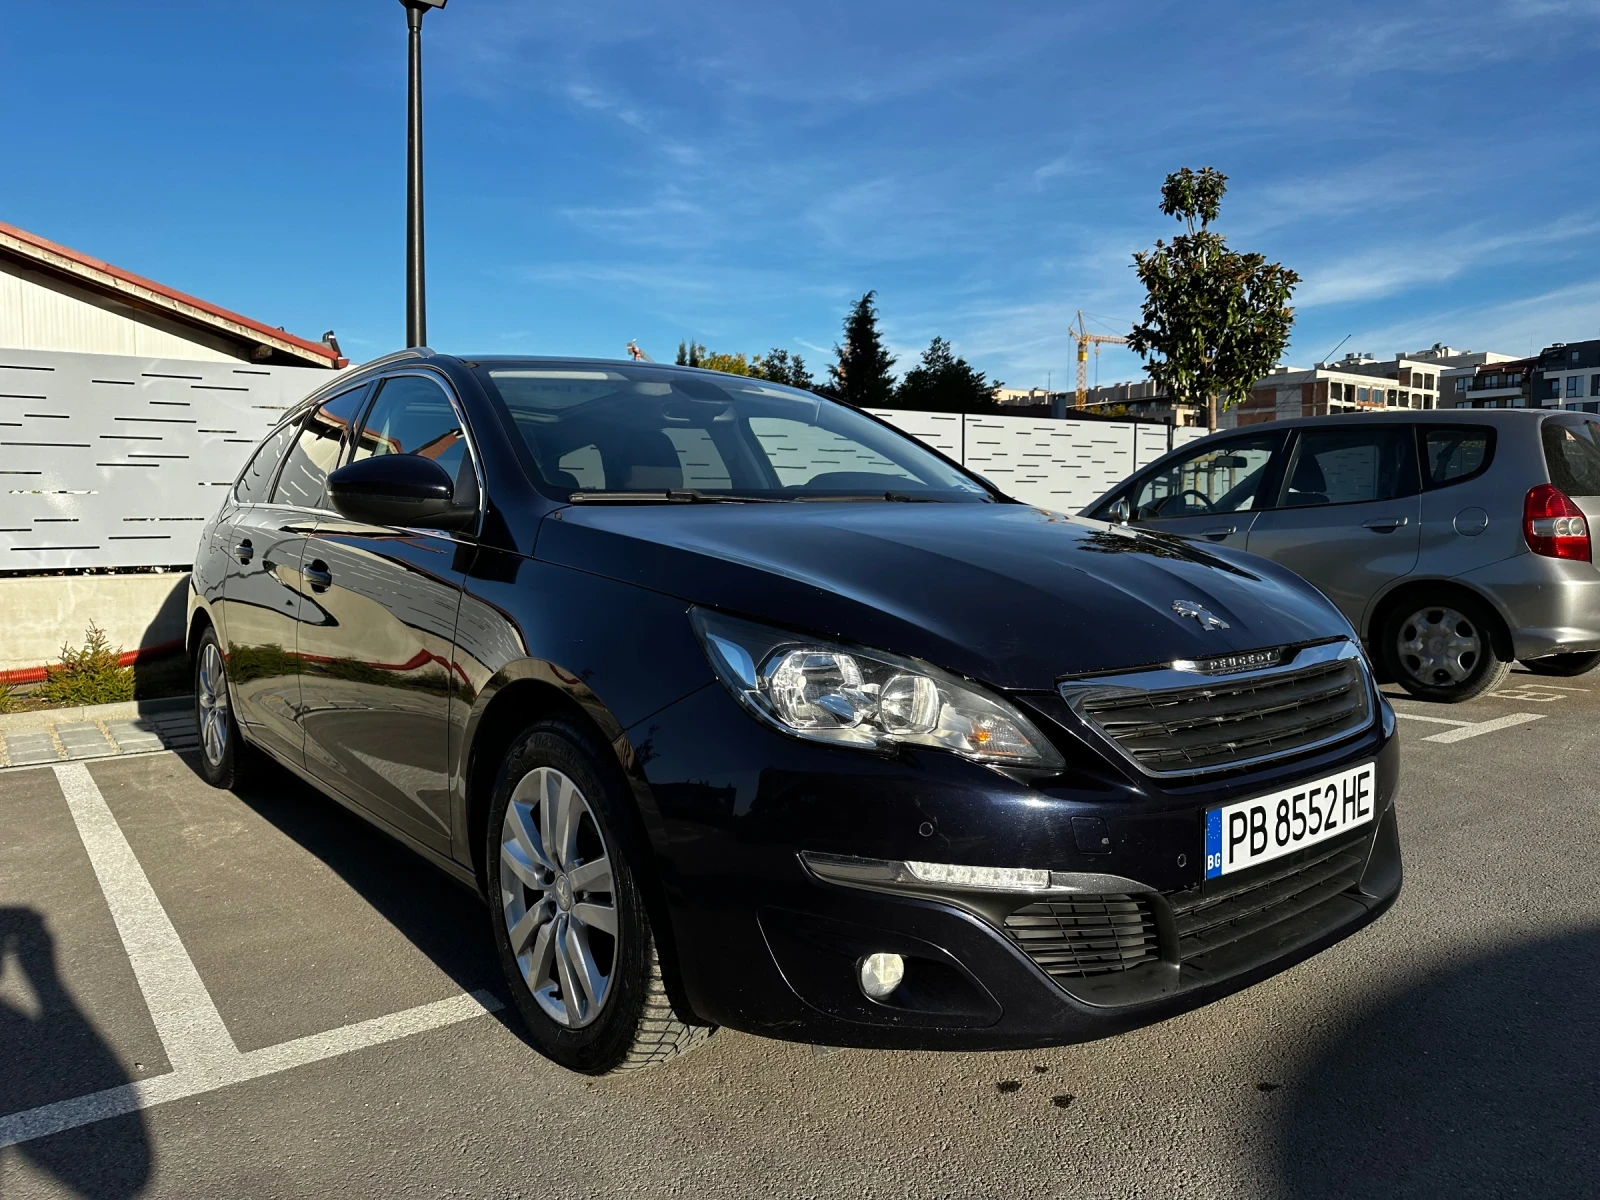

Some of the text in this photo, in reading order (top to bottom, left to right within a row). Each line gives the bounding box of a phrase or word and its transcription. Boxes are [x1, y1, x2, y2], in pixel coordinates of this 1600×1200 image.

[1209, 651, 1272, 670] PEUGEOT
[1228, 770, 1370, 864] PB 8552 HE
[1206, 853, 1221, 871] BG
